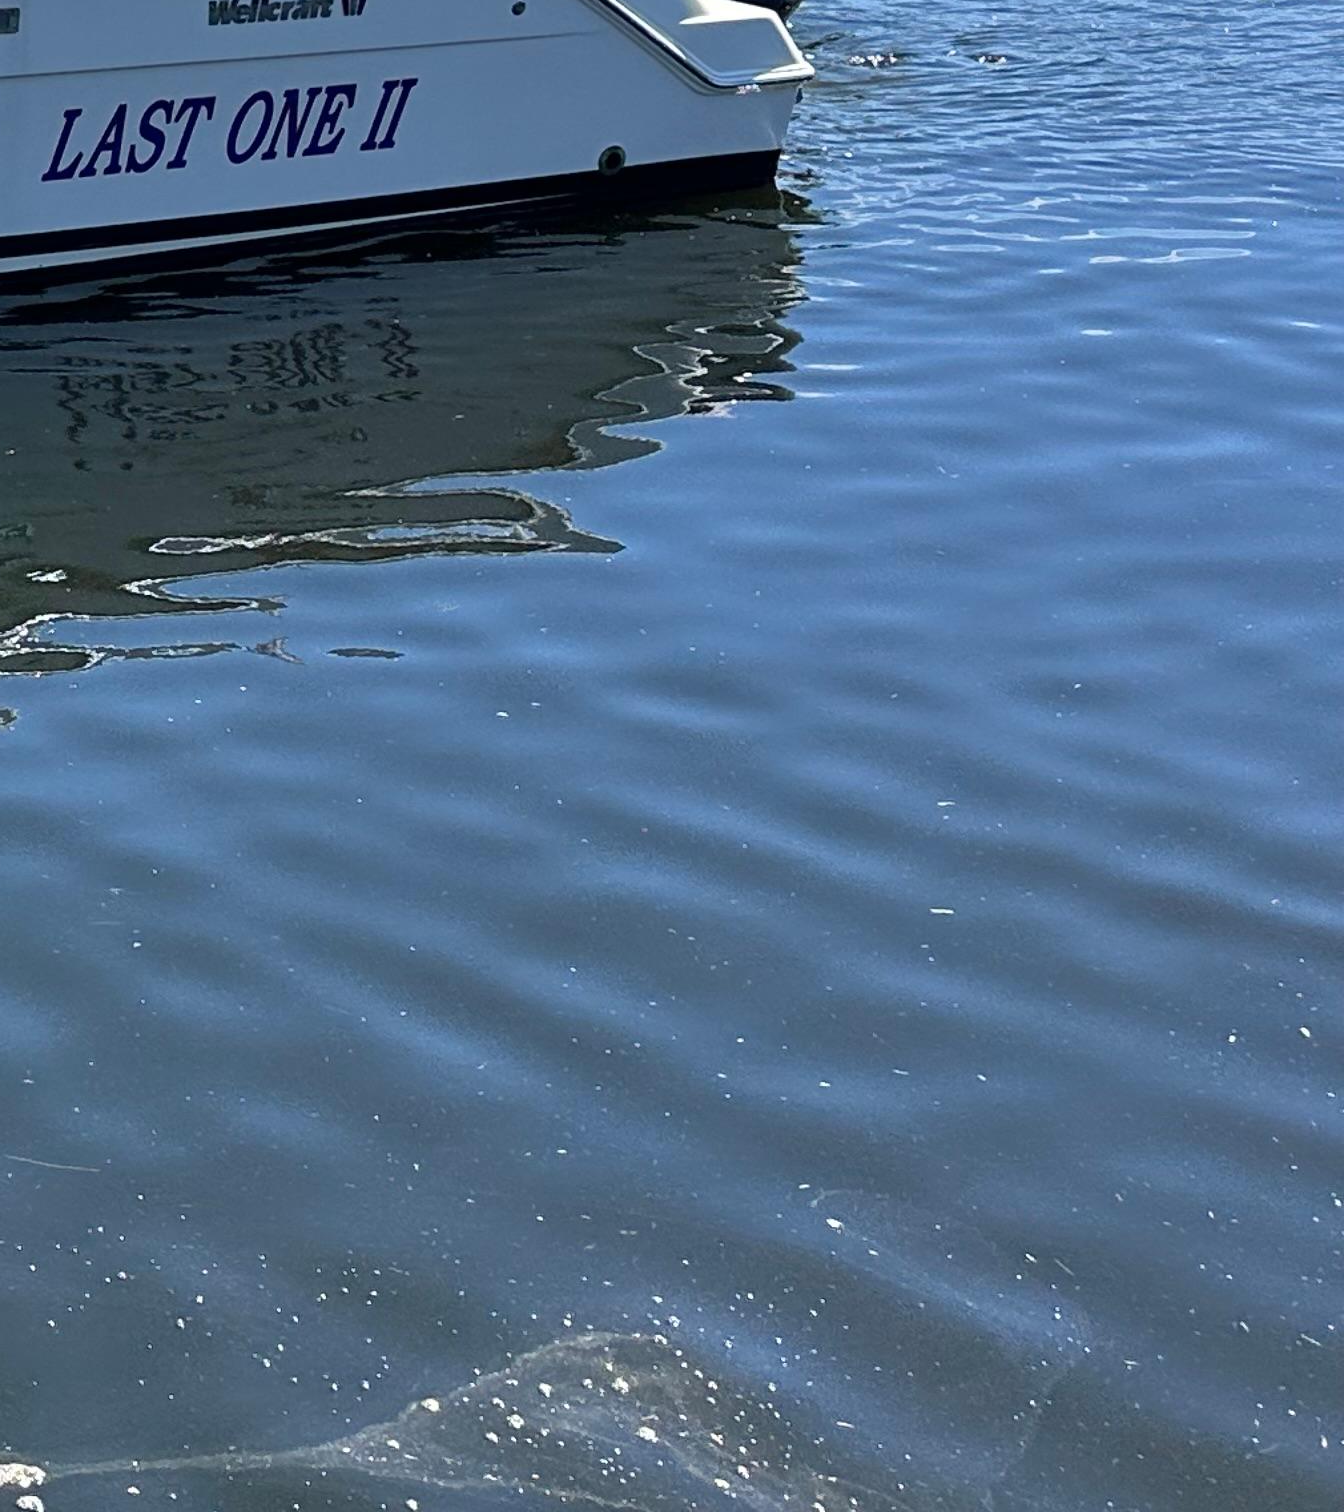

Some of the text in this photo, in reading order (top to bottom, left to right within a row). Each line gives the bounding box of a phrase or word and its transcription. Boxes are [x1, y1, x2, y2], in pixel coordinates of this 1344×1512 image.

[41, 77, 419, 182] LAST ONE II
